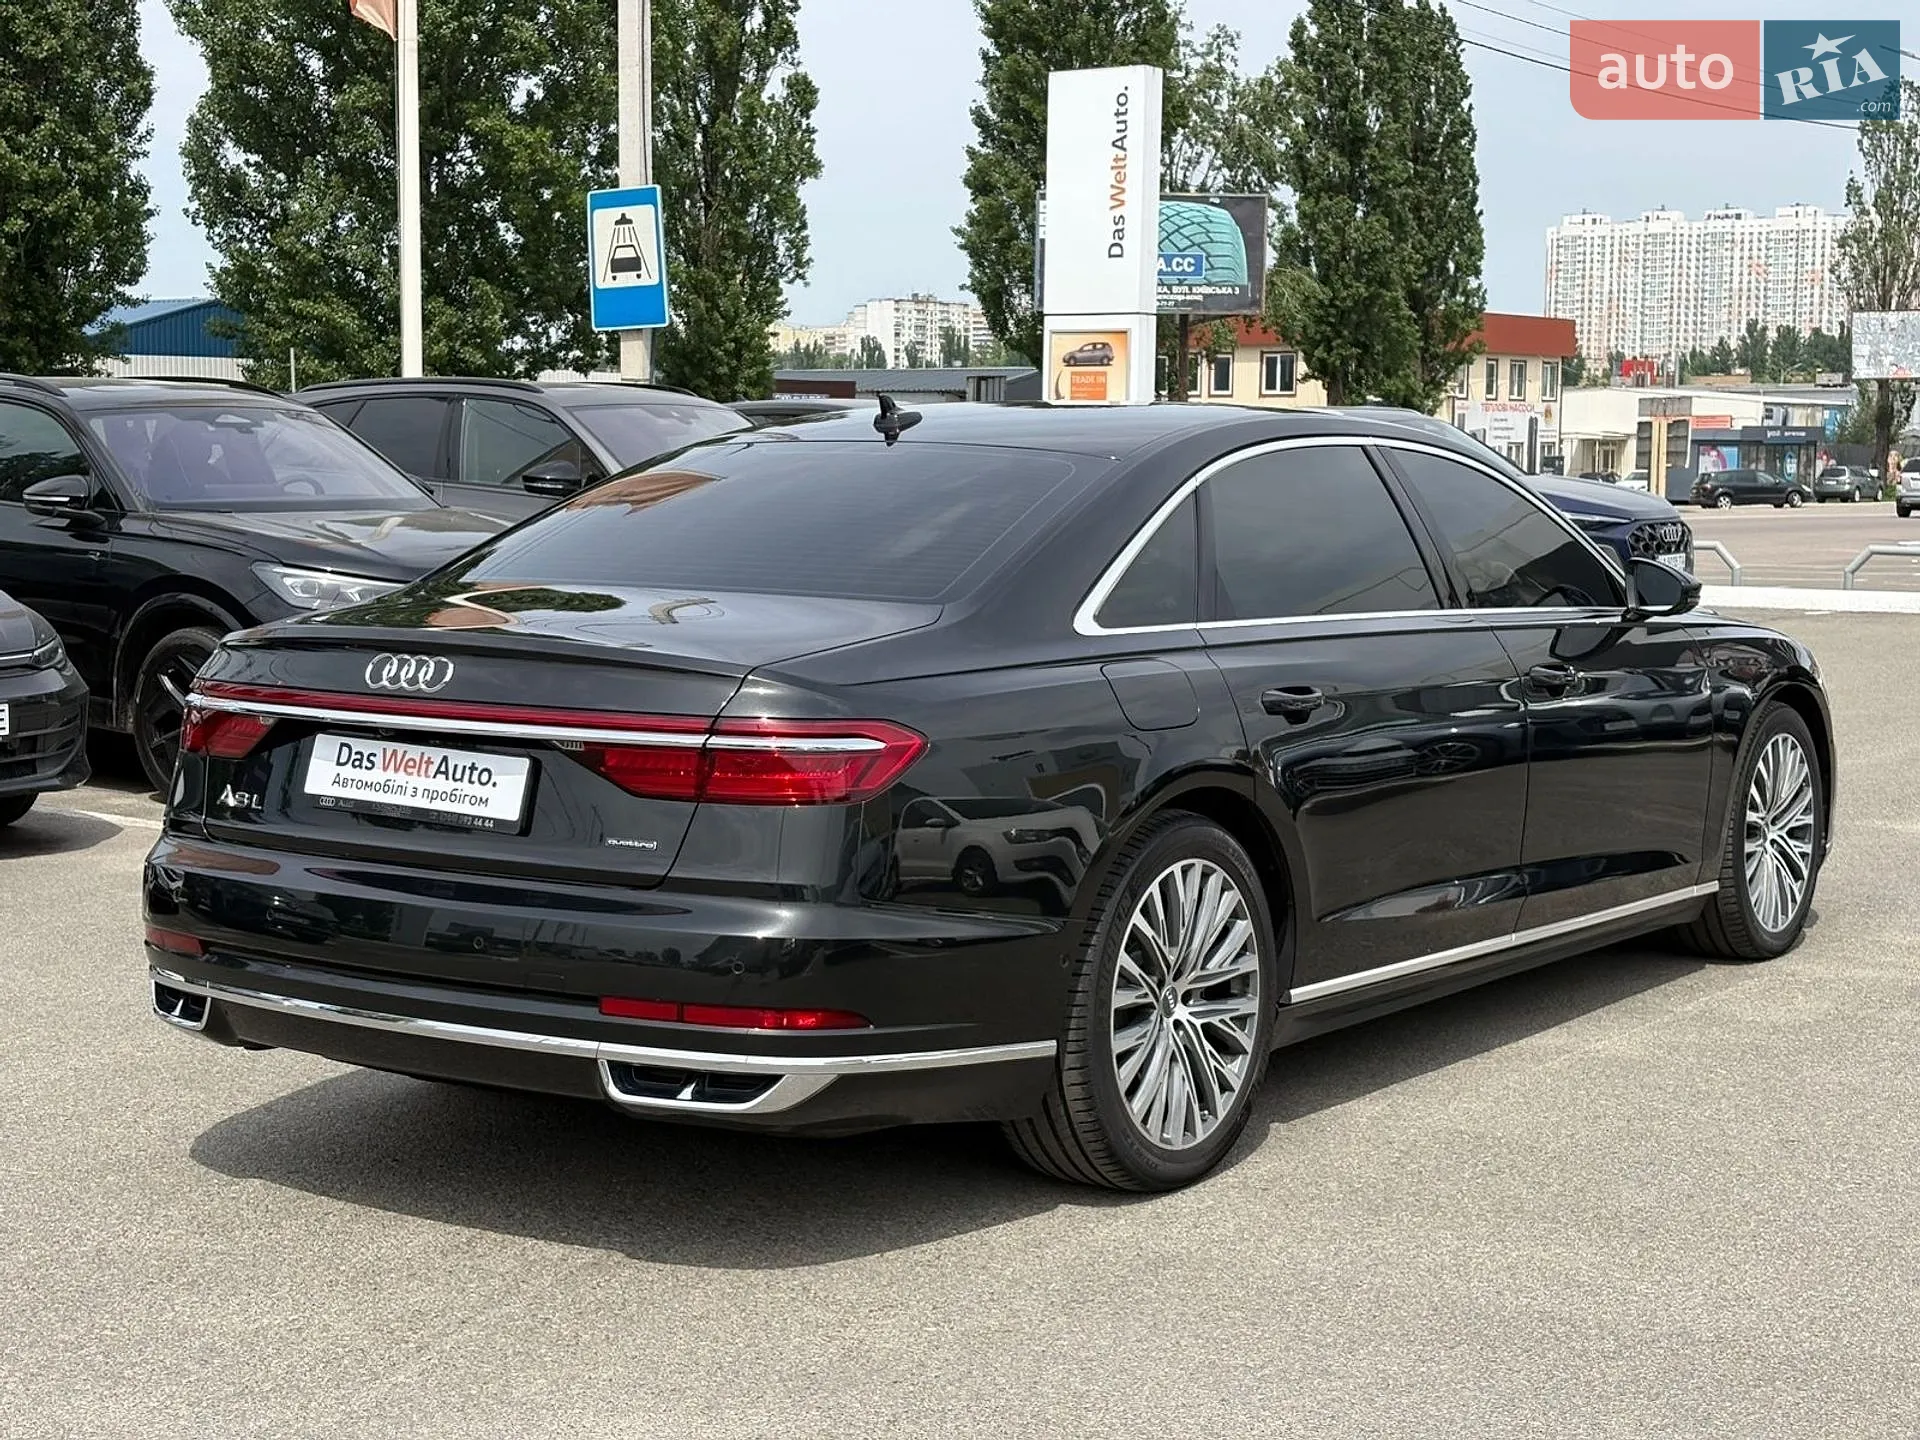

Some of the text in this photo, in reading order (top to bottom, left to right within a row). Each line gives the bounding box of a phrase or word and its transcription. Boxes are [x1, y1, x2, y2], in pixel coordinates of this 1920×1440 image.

[1108, 85, 1129, 259] Das WeltAuto.
[335, 741, 498, 788] Das WeltAuto.
[331, 772, 489, 808] Автомобілі з пробігом
[473, 817, 483, 827] 44
[484, 818, 494, 829] 44
